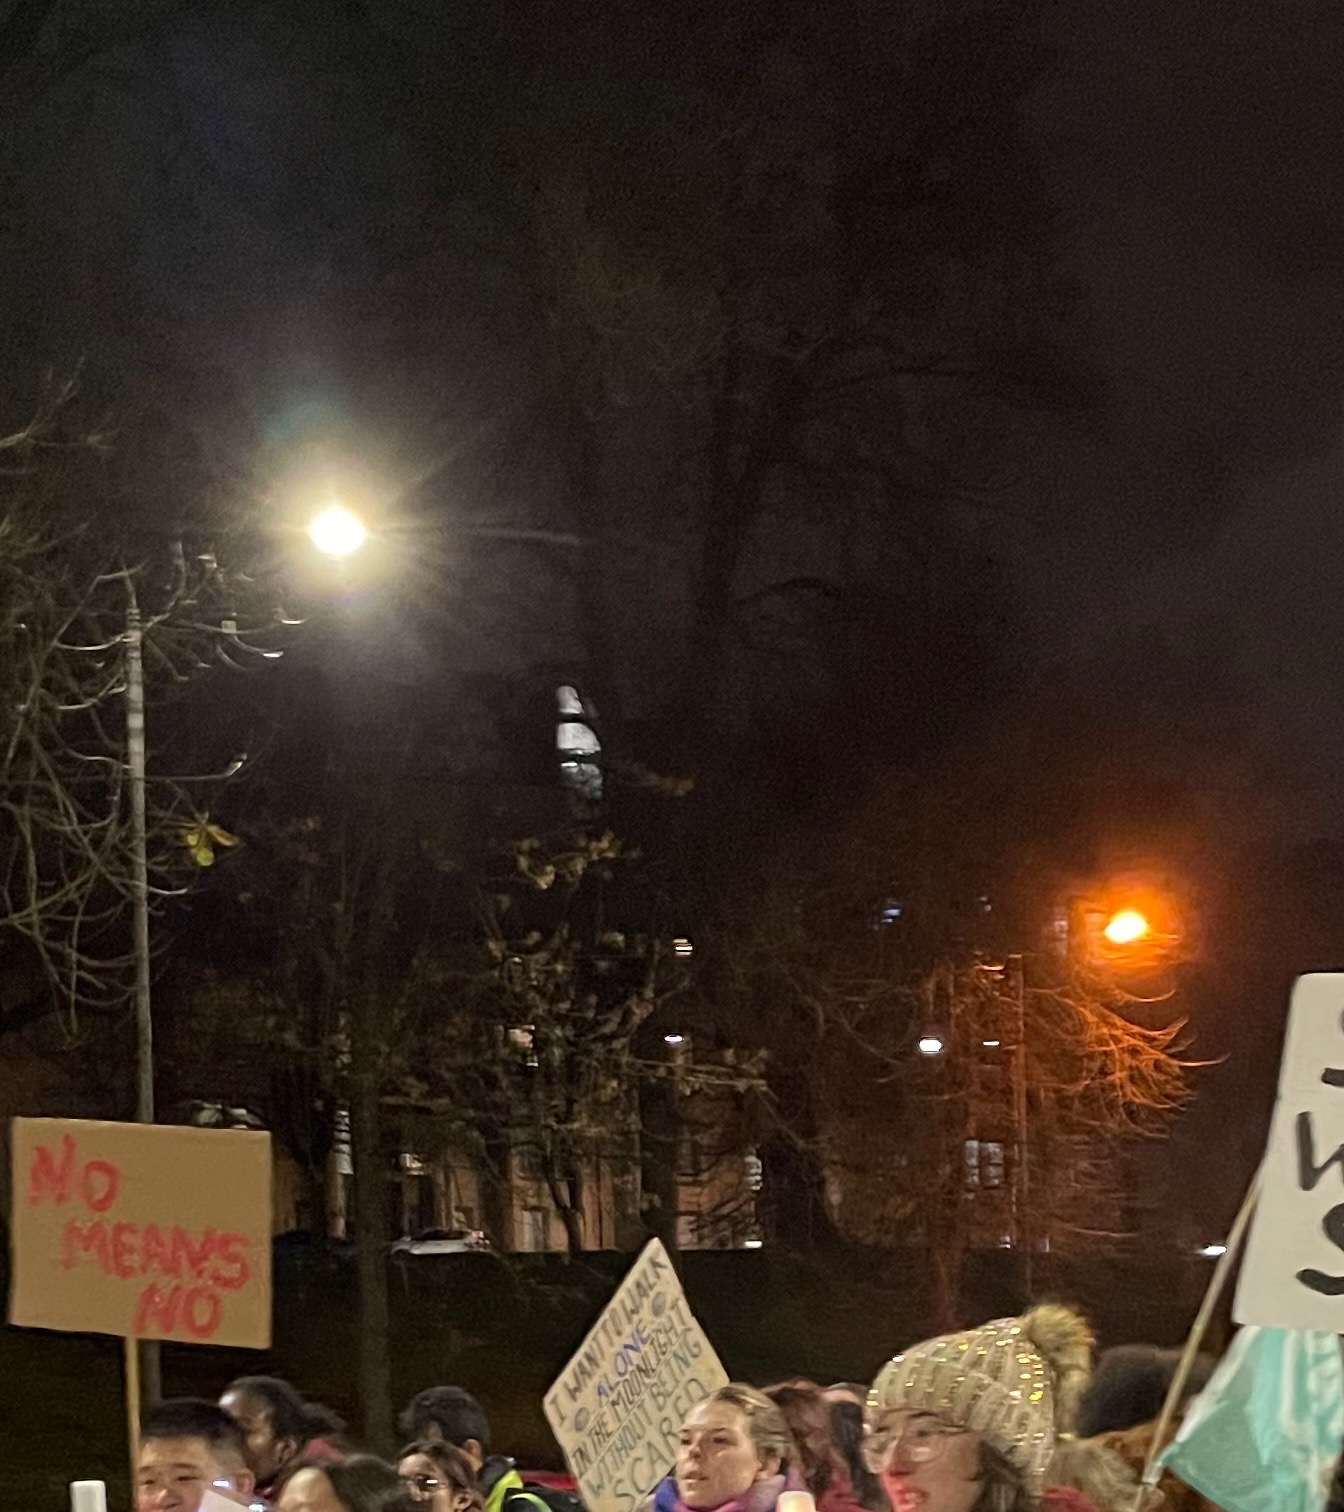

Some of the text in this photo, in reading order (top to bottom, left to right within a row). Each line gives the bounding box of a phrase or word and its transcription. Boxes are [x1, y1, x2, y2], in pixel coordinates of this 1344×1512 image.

[27, 1133, 121, 1213] NO
[60, 1218, 253, 1291] MEANS
[131, 1282, 224, 1339] NO
[549, 1255, 668, 1426] I WANT TO WALK
[571, 1297, 691, 1478] IN THE MOONLIGHT
[596, 1318, 651, 1402] ALONE
[585, 1327, 701, 1497] WITHOUT BEING
